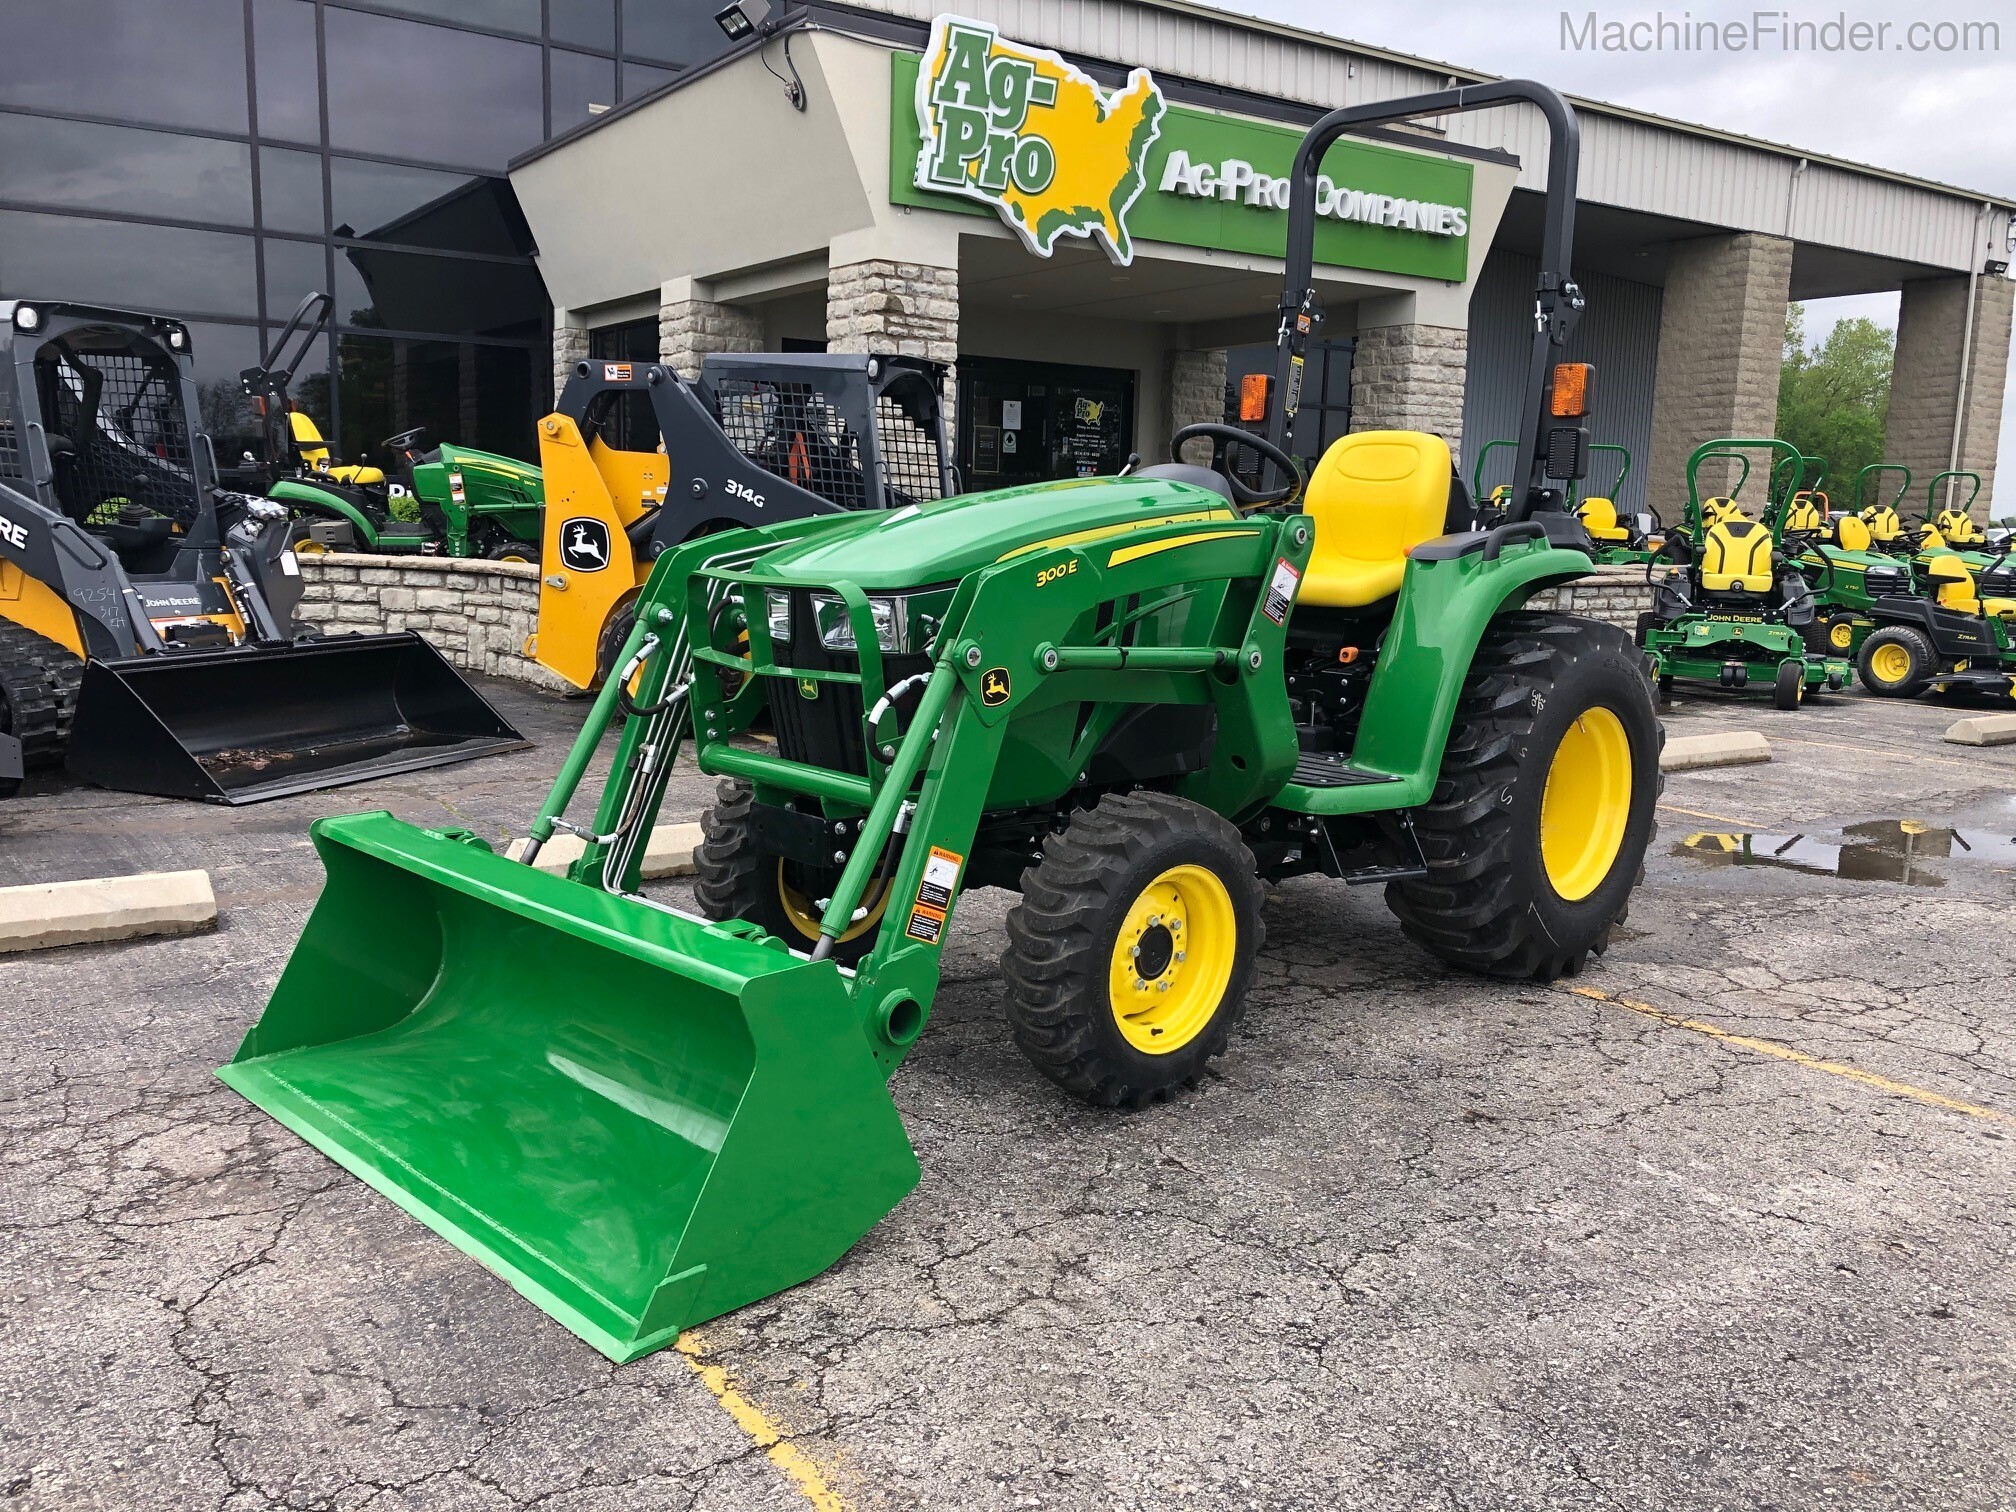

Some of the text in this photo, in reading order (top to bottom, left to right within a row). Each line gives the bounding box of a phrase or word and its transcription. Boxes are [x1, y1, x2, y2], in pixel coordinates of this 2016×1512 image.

[931, 24, 1058, 132] Ag-
[929, 104, 1055, 194] Pro
[1315, 174, 1468, 237] COMPANIES
[724, 479, 766, 508] 314G
[1036, 564, 1066, 588] 300
[73, 587, 117, 604] 9254
[145, 597, 202, 608] JOHN DEERE
[1708, 613, 1762, 623] JOHN DEERE
